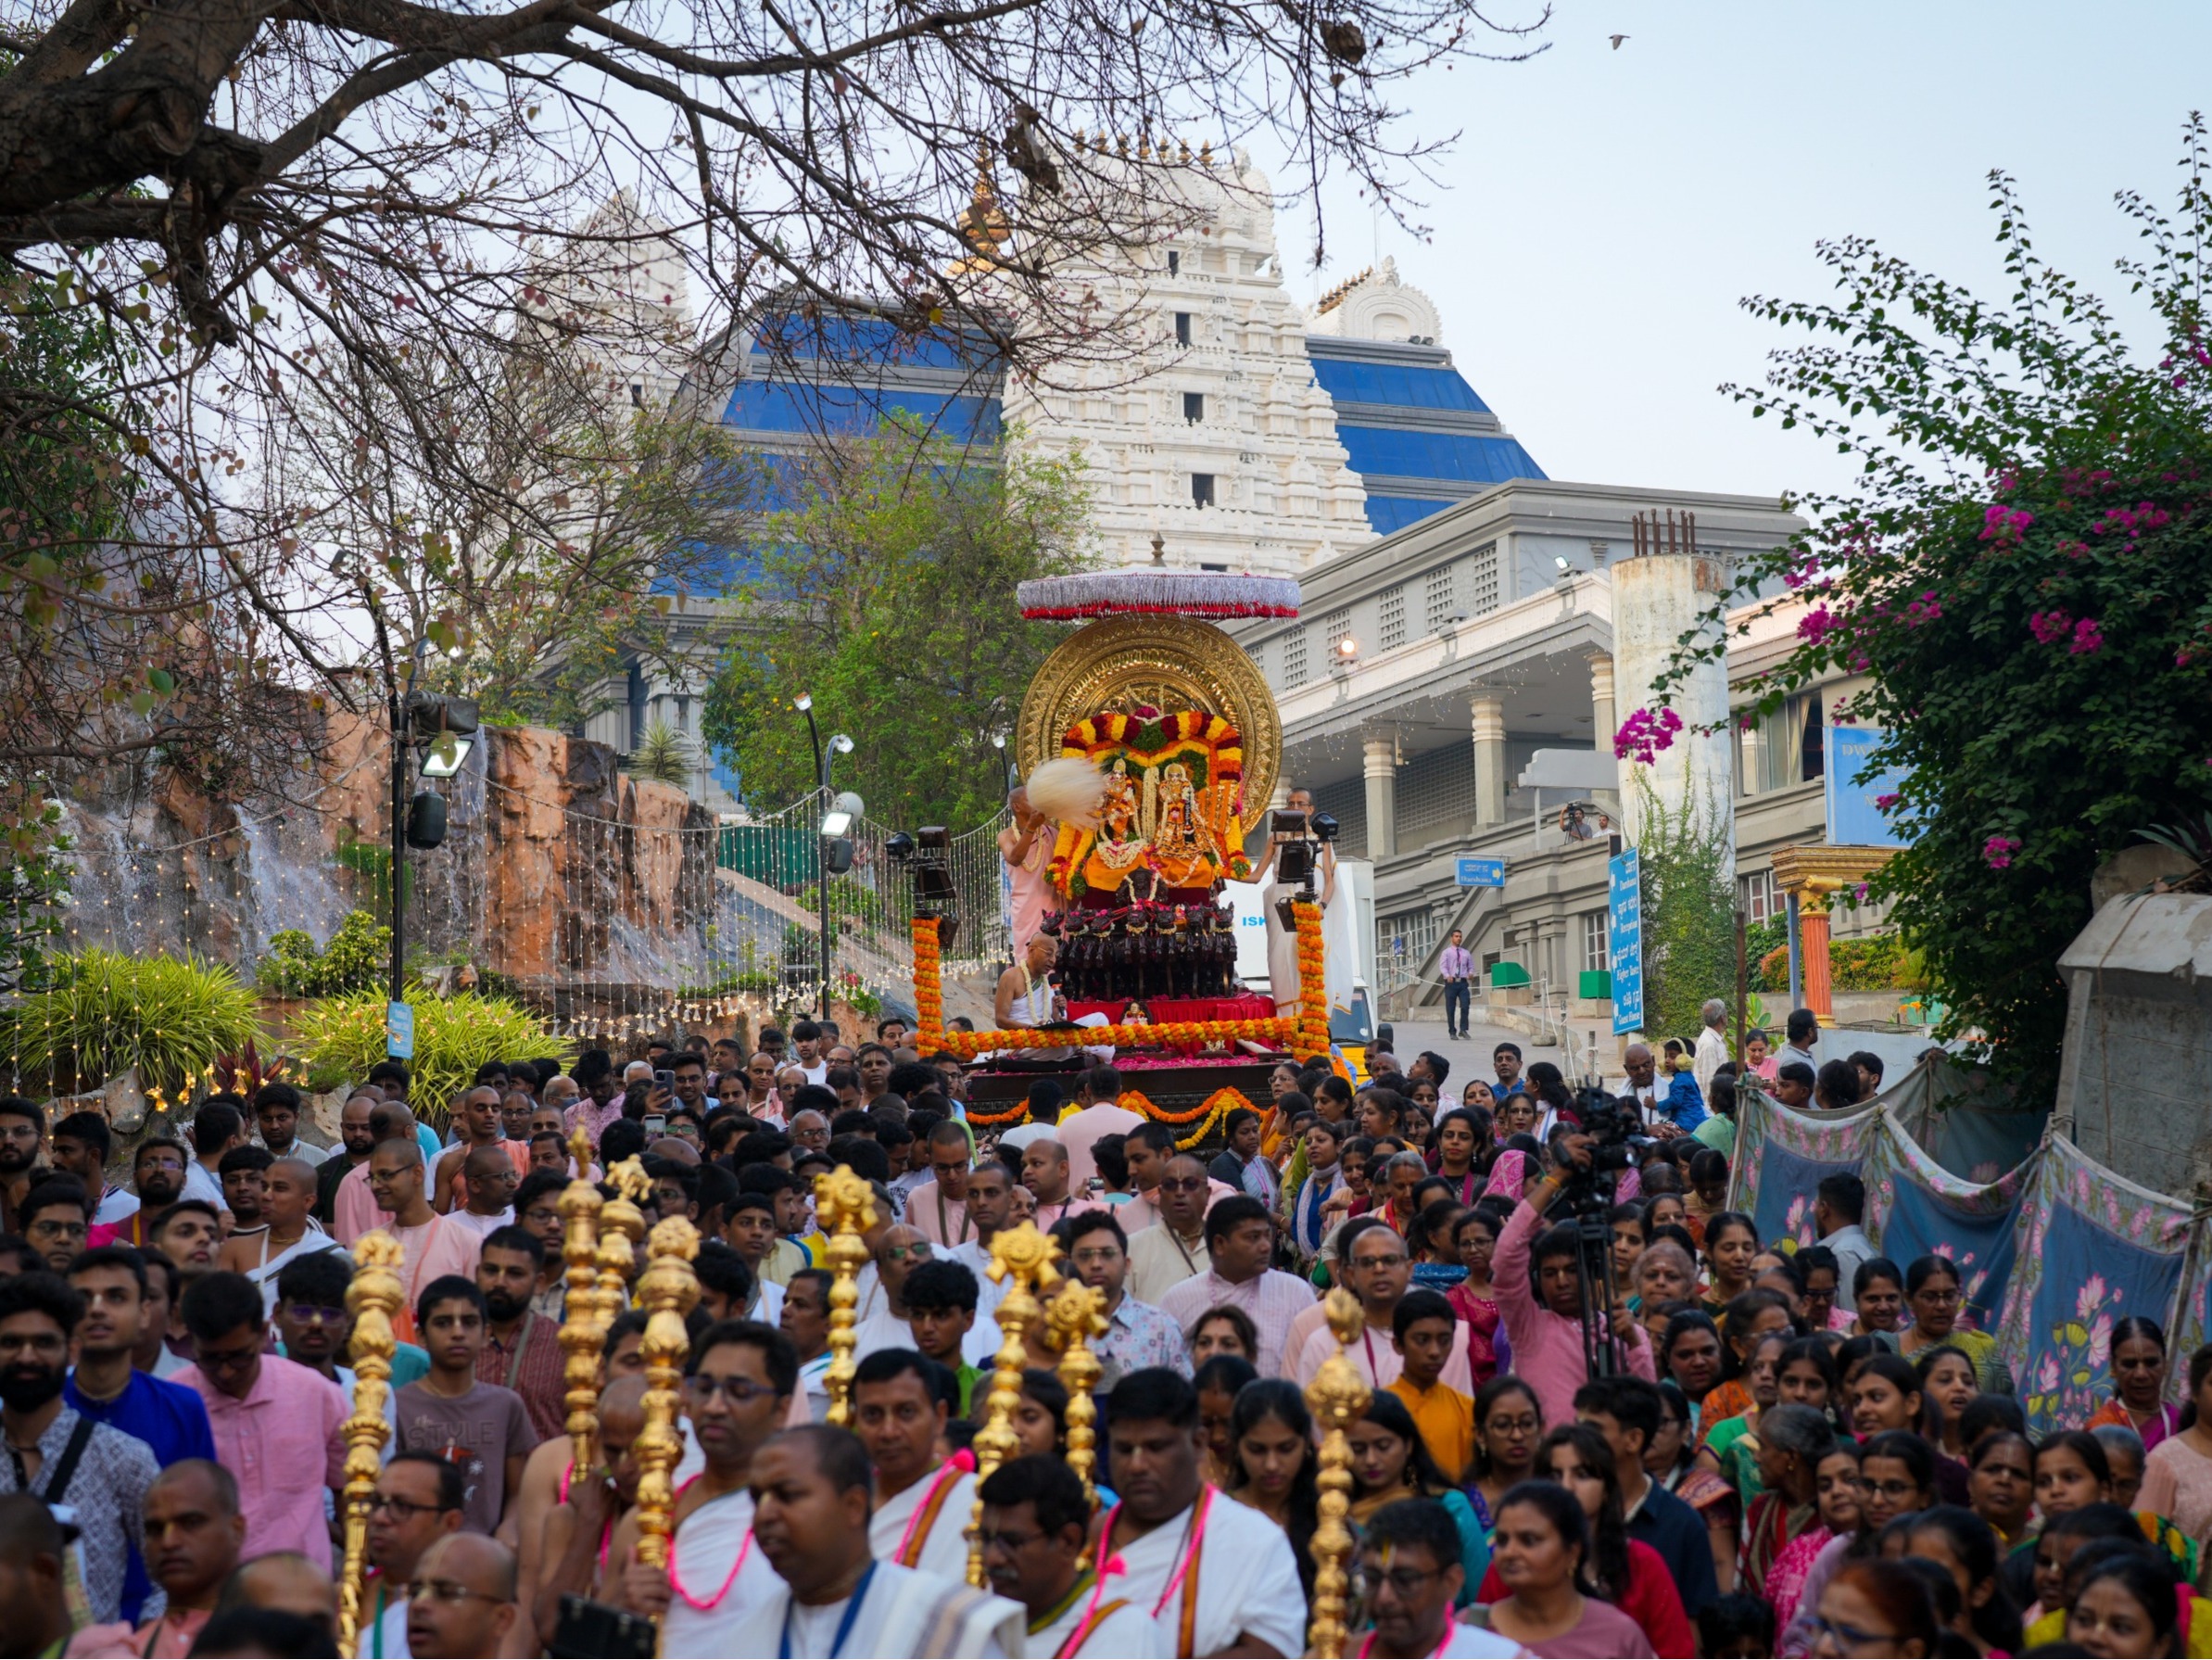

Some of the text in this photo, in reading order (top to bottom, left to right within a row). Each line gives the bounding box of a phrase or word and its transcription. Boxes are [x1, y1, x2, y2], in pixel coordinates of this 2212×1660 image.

[1460, 875, 1492, 883] Darshana
[1620, 877, 1637, 891] Darshana
[1621, 919, 1637, 934] Reception
[1617, 968, 1629, 982] Higher
[1618, 1011, 1640, 1025] Guest House
[408, 1420, 497, 1448] STYLE
